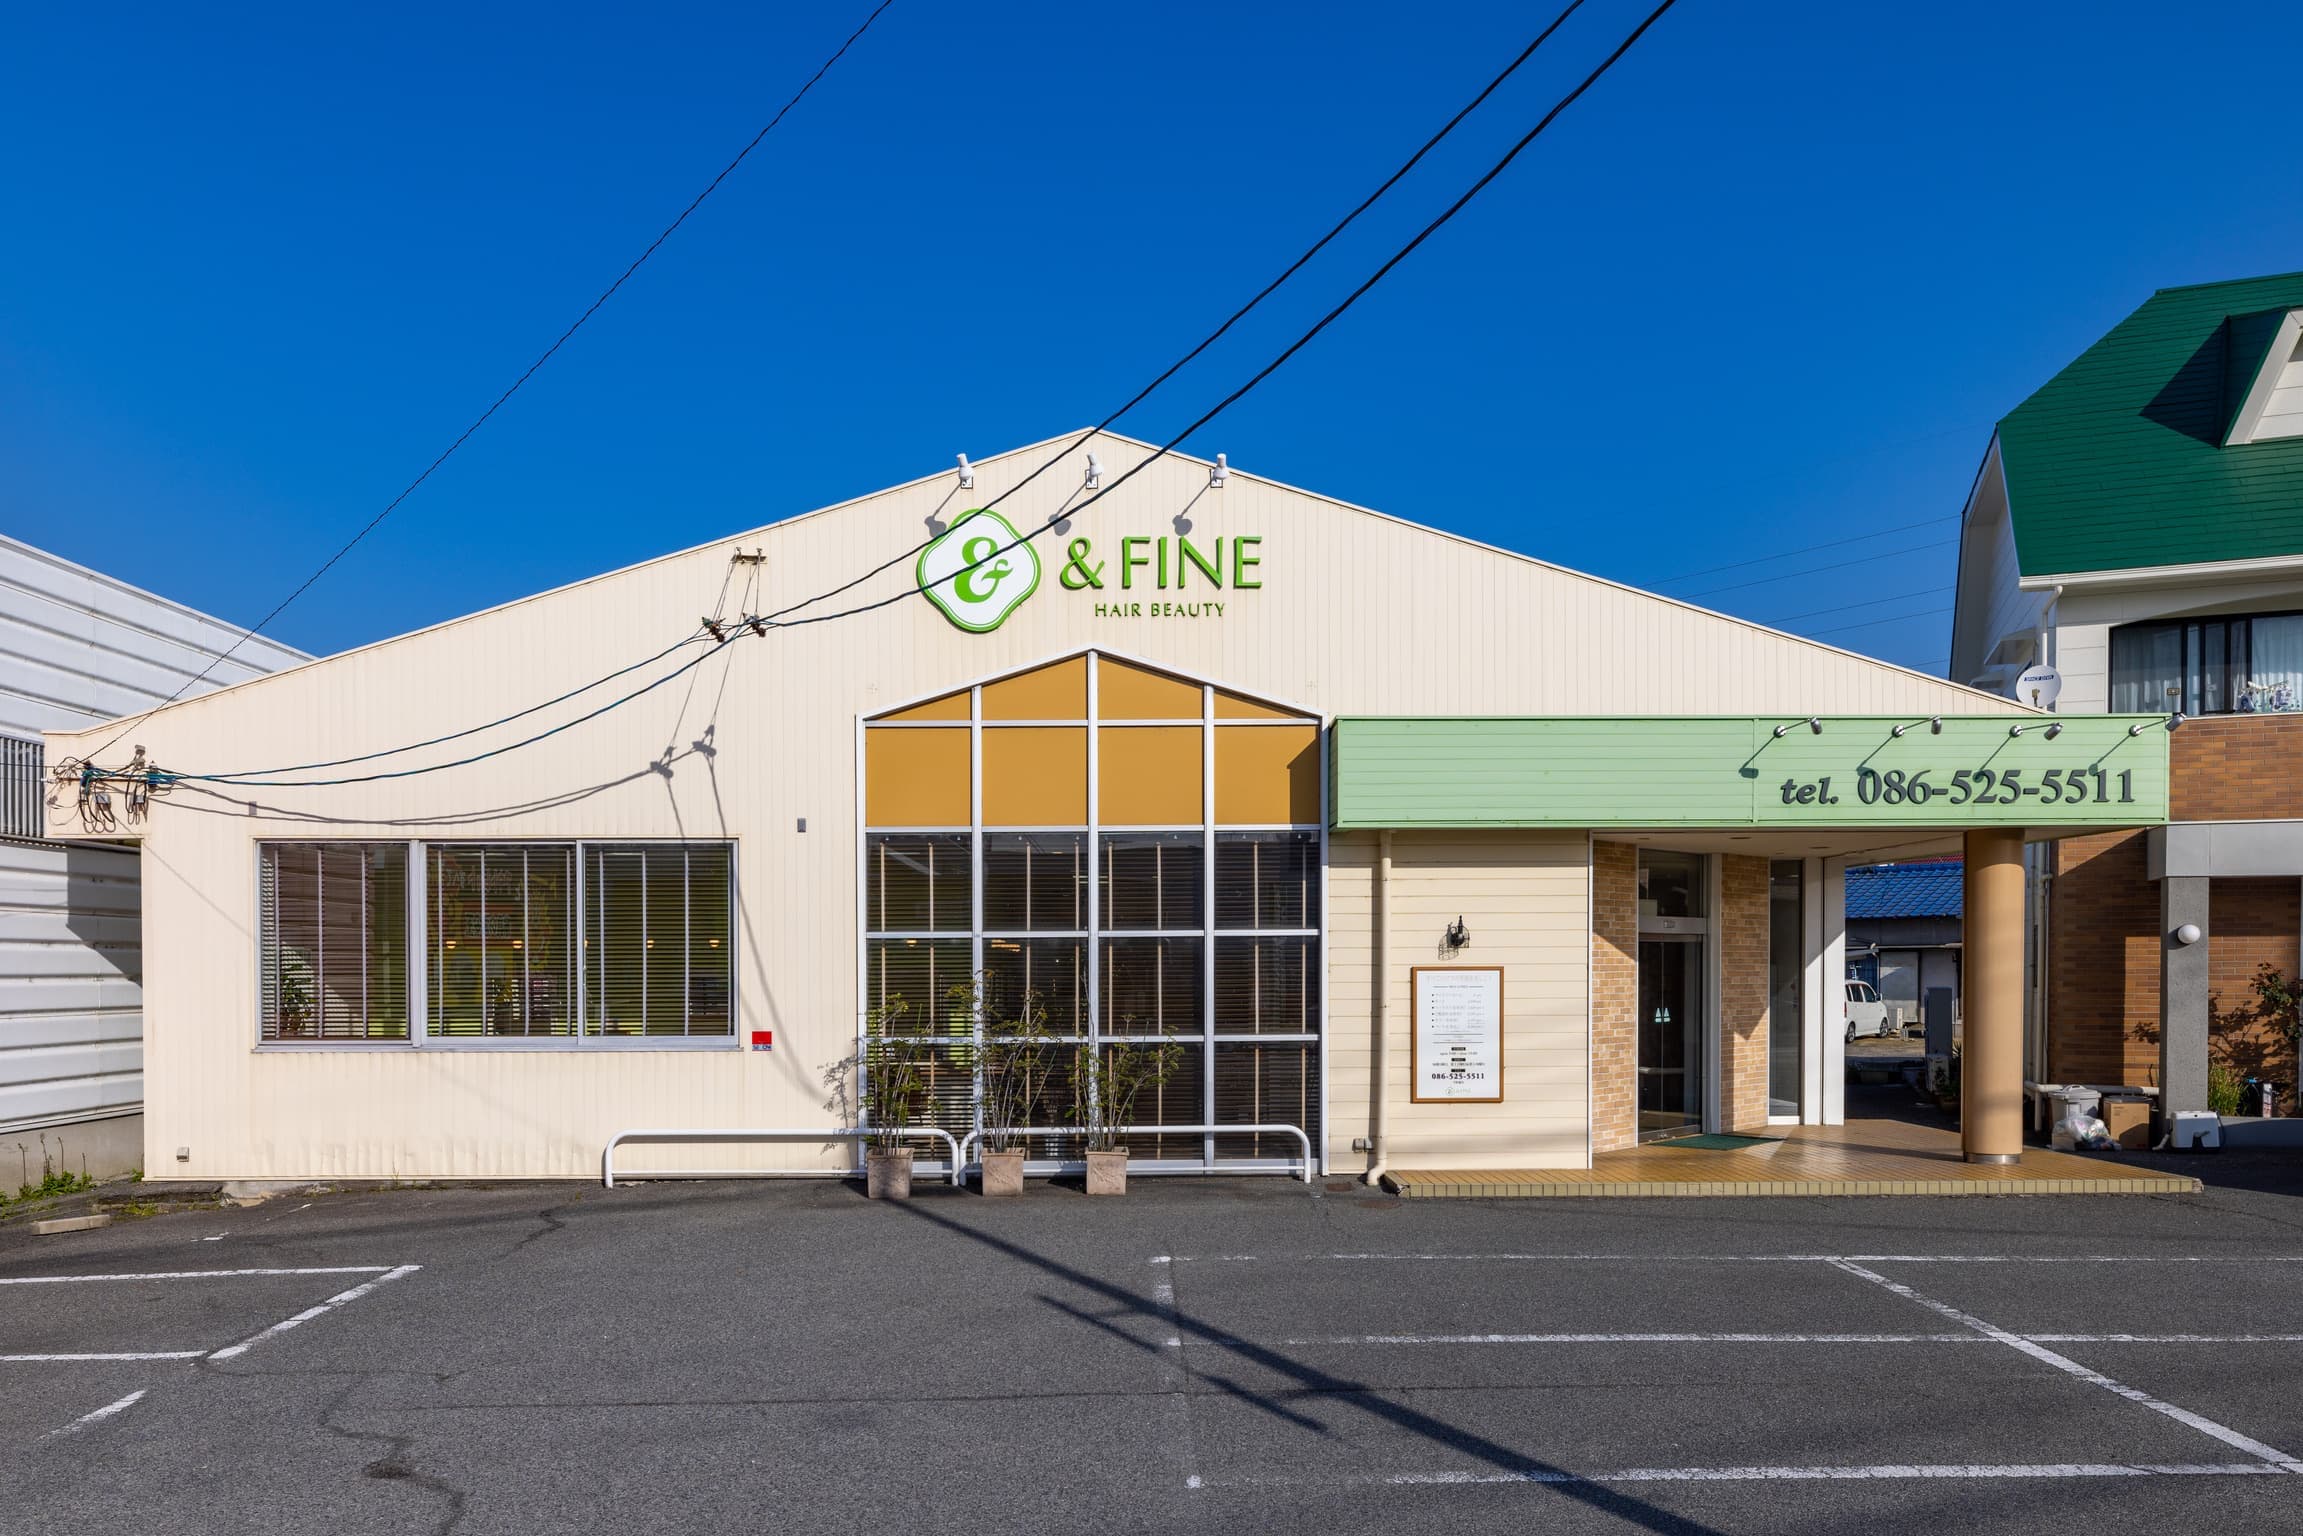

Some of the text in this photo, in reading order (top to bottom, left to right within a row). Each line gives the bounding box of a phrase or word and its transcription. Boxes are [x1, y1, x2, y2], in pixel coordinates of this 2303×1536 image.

[1060, 536, 1263, 589] & FINE
[1095, 603, 1226, 617] HAIR BEAUTY
[1780, 769, 2135, 805] tel. 086-525-5511
